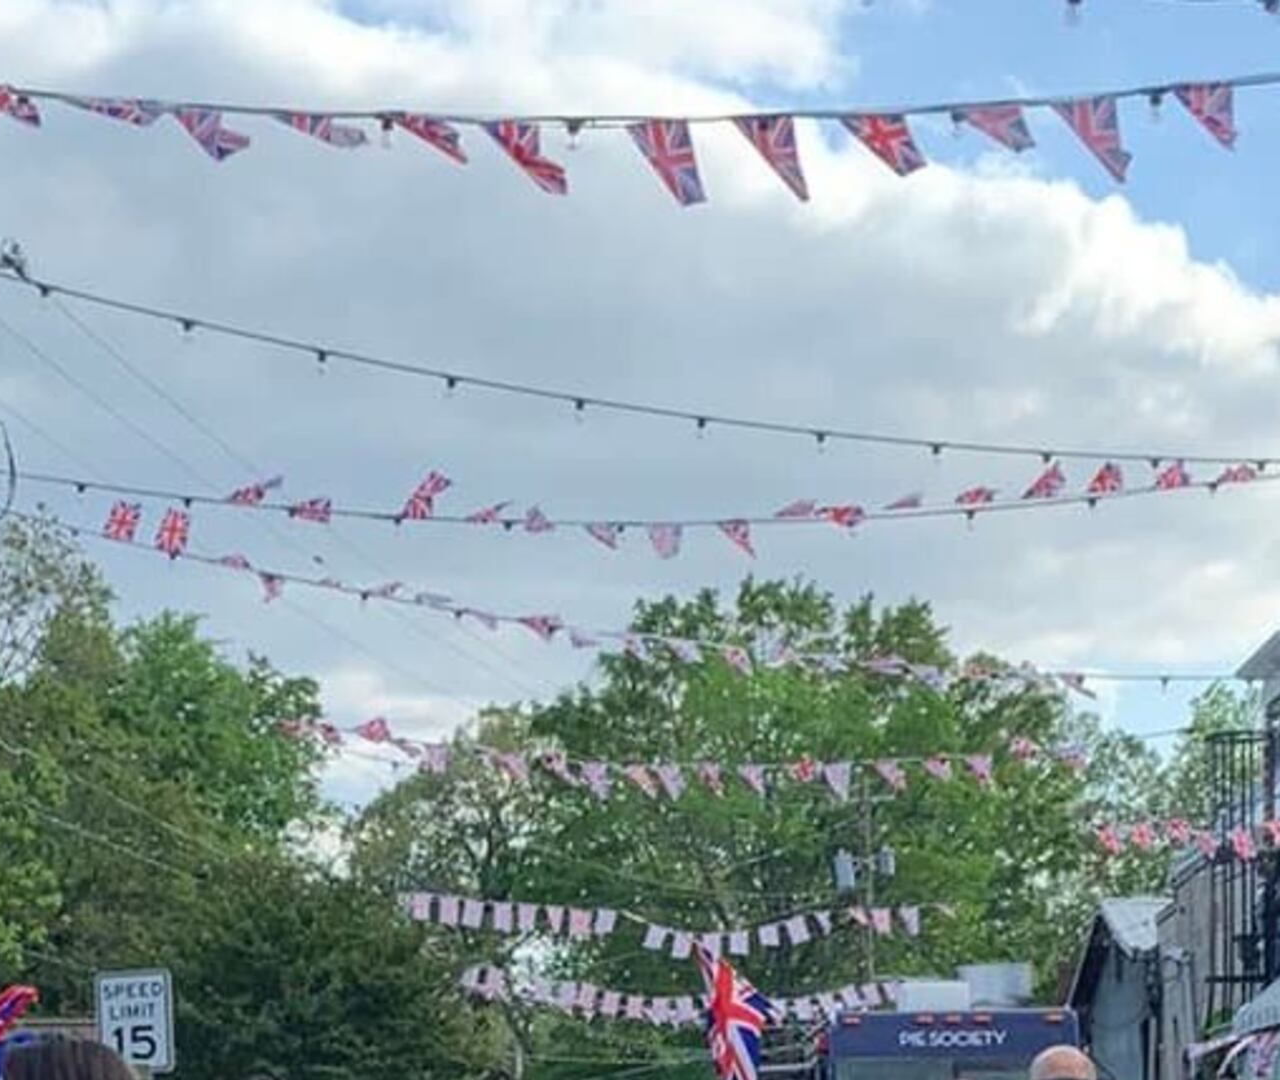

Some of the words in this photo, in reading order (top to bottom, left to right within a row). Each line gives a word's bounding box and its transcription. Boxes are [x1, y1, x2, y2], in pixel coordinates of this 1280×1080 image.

[103, 982, 162, 999] SPEED
[109, 1003, 154, 1020] LIMIT
[112, 1025, 157, 1059] 15
[899, 1030, 925, 1046] PIE
[928, 1030, 1007, 1046] SOCIETY
